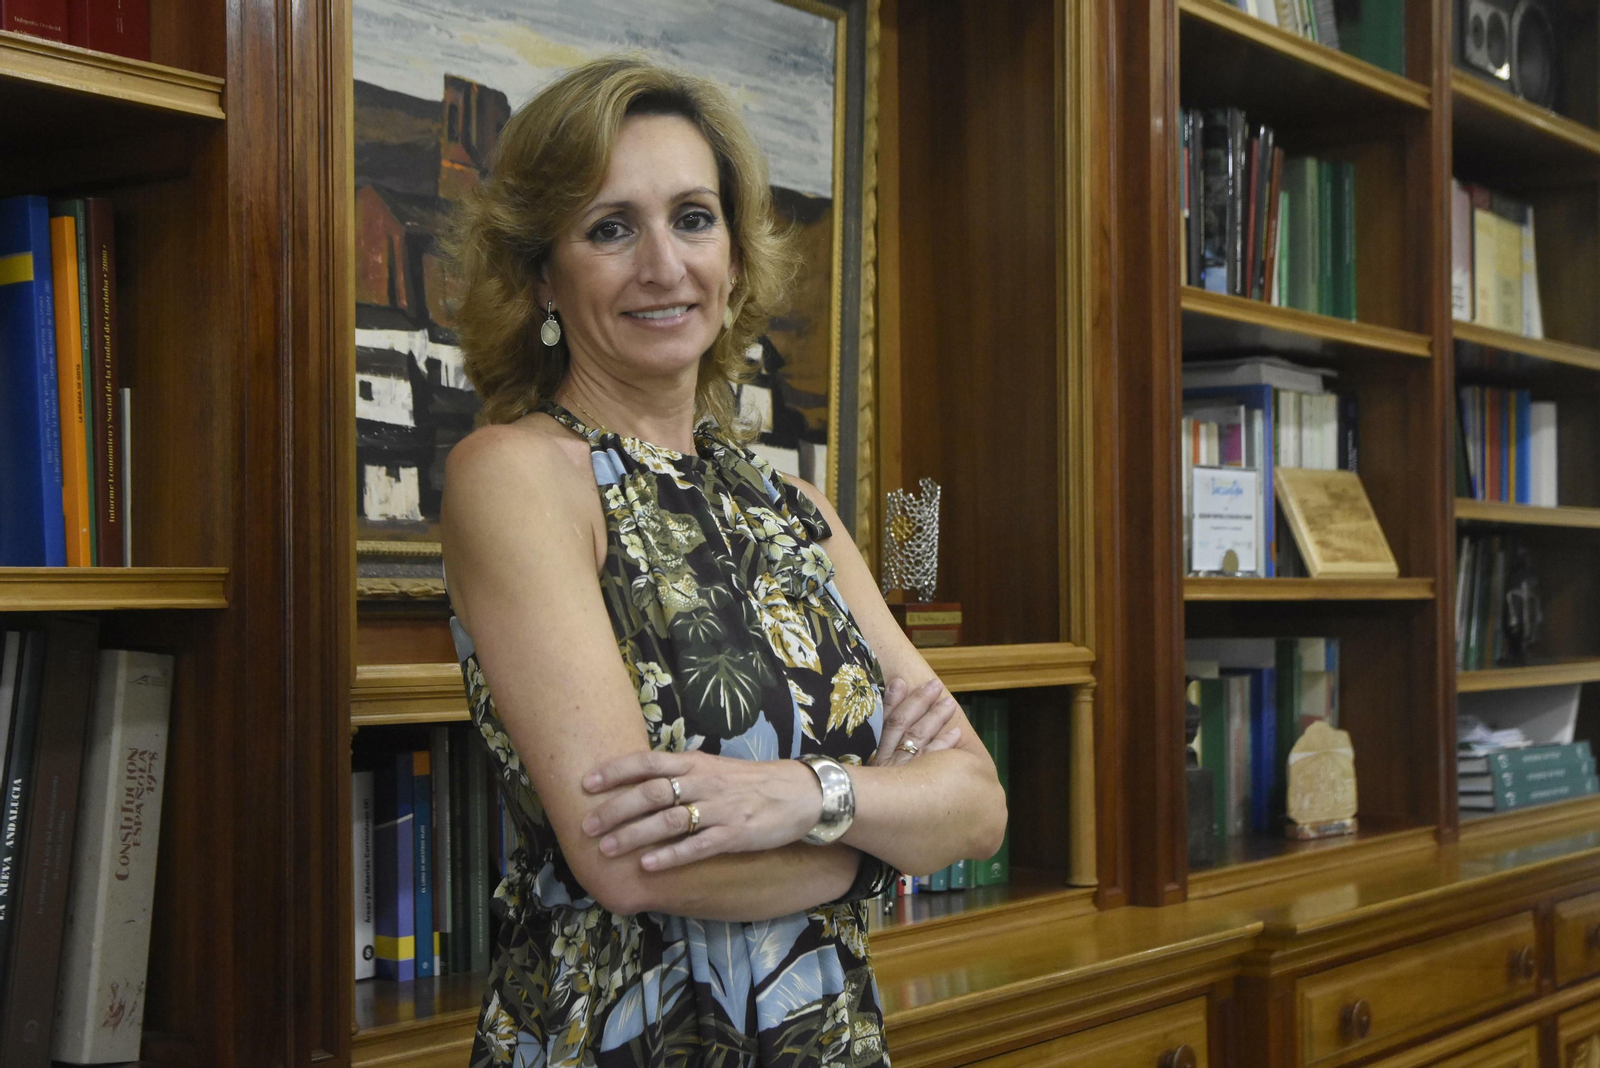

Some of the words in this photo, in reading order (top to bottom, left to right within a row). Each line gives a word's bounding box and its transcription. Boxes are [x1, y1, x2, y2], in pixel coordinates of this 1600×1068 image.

[101, 279, 110, 320] Córdoba
[103, 321, 110, 333] de
[103, 335, 111, 368] Ciudad
[104, 370, 112, 379] la
[105, 380, 112, 392] de
[105, 393, 113, 422] Social
[106, 430, 115, 483] Económico
[108, 485, 116, 523] Informe
[144, 751, 158, 795] 1978
[5, 778, 22, 849] ANDALUCIA
[132, 750, 148, 847] ESPAÑOLA
[363, 811, 371, 858] Curriculares
[0, 856, 12, 897] NUEVA
[363, 860, 371, 894] Materias
[364, 902, 372, 924] Áreas
